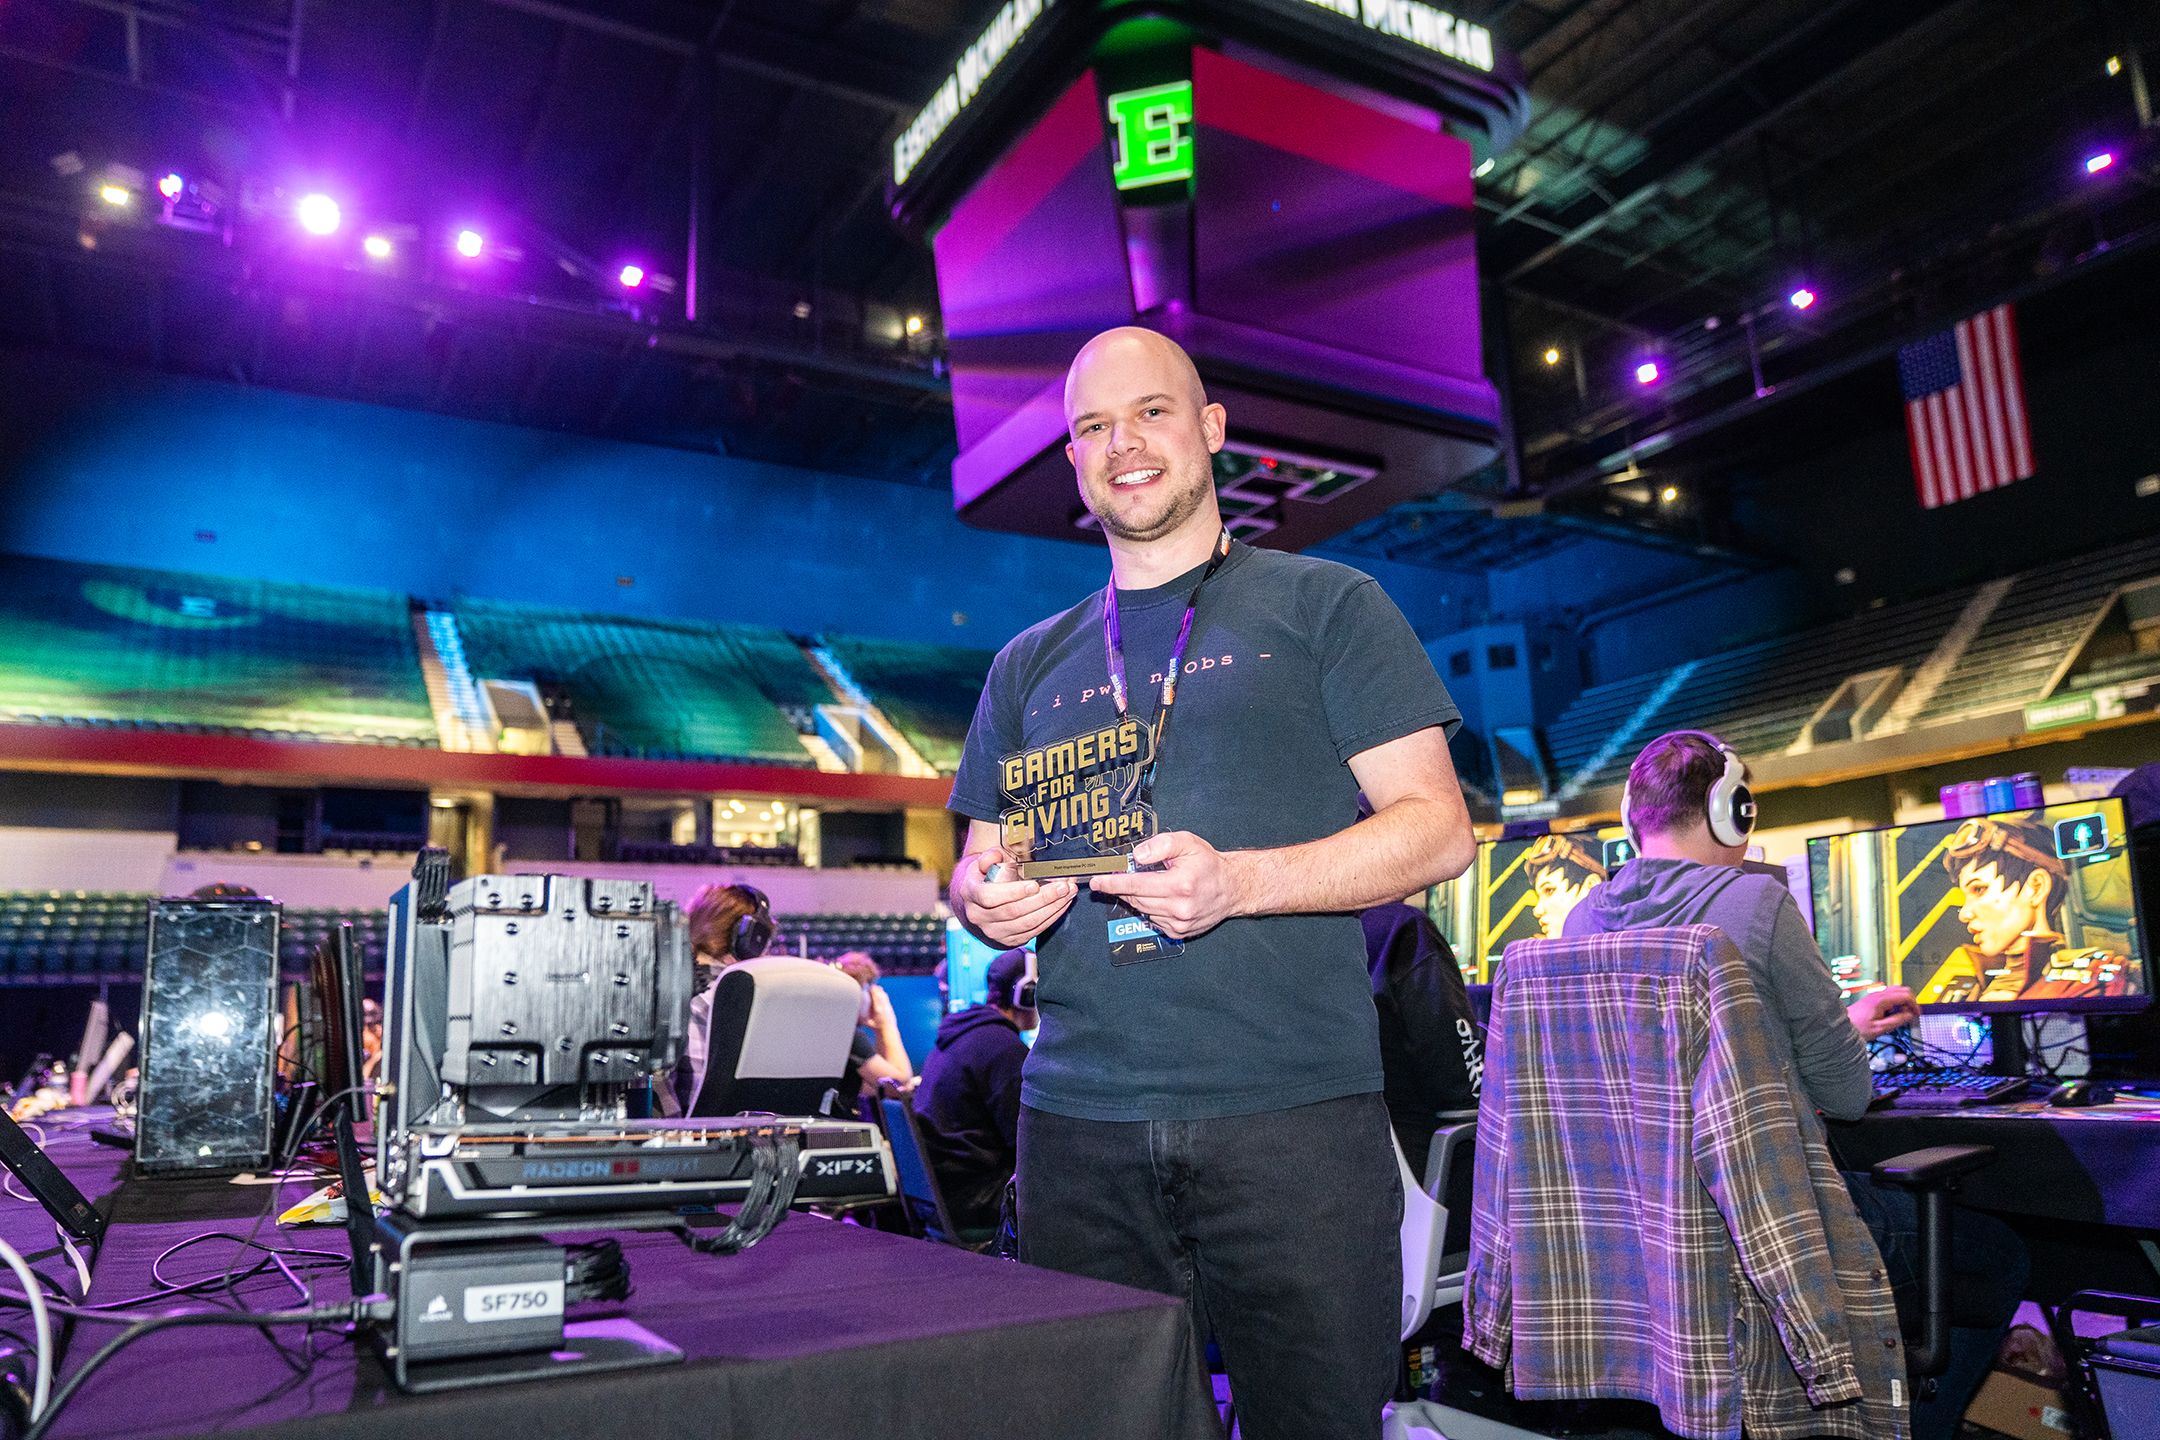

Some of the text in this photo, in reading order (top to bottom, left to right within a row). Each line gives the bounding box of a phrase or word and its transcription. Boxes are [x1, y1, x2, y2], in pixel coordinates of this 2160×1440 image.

[1149, 655, 1233, 684] nobs
[1005, 722, 1138, 791] GAMERS
[1037, 774, 1075, 803] FOR
[1006, 786, 1110, 845] GIVING
[1093, 810, 1144, 843] 2024
[1115, 921, 1153, 936] GENE
[481, 1291, 548, 1313] SF750
